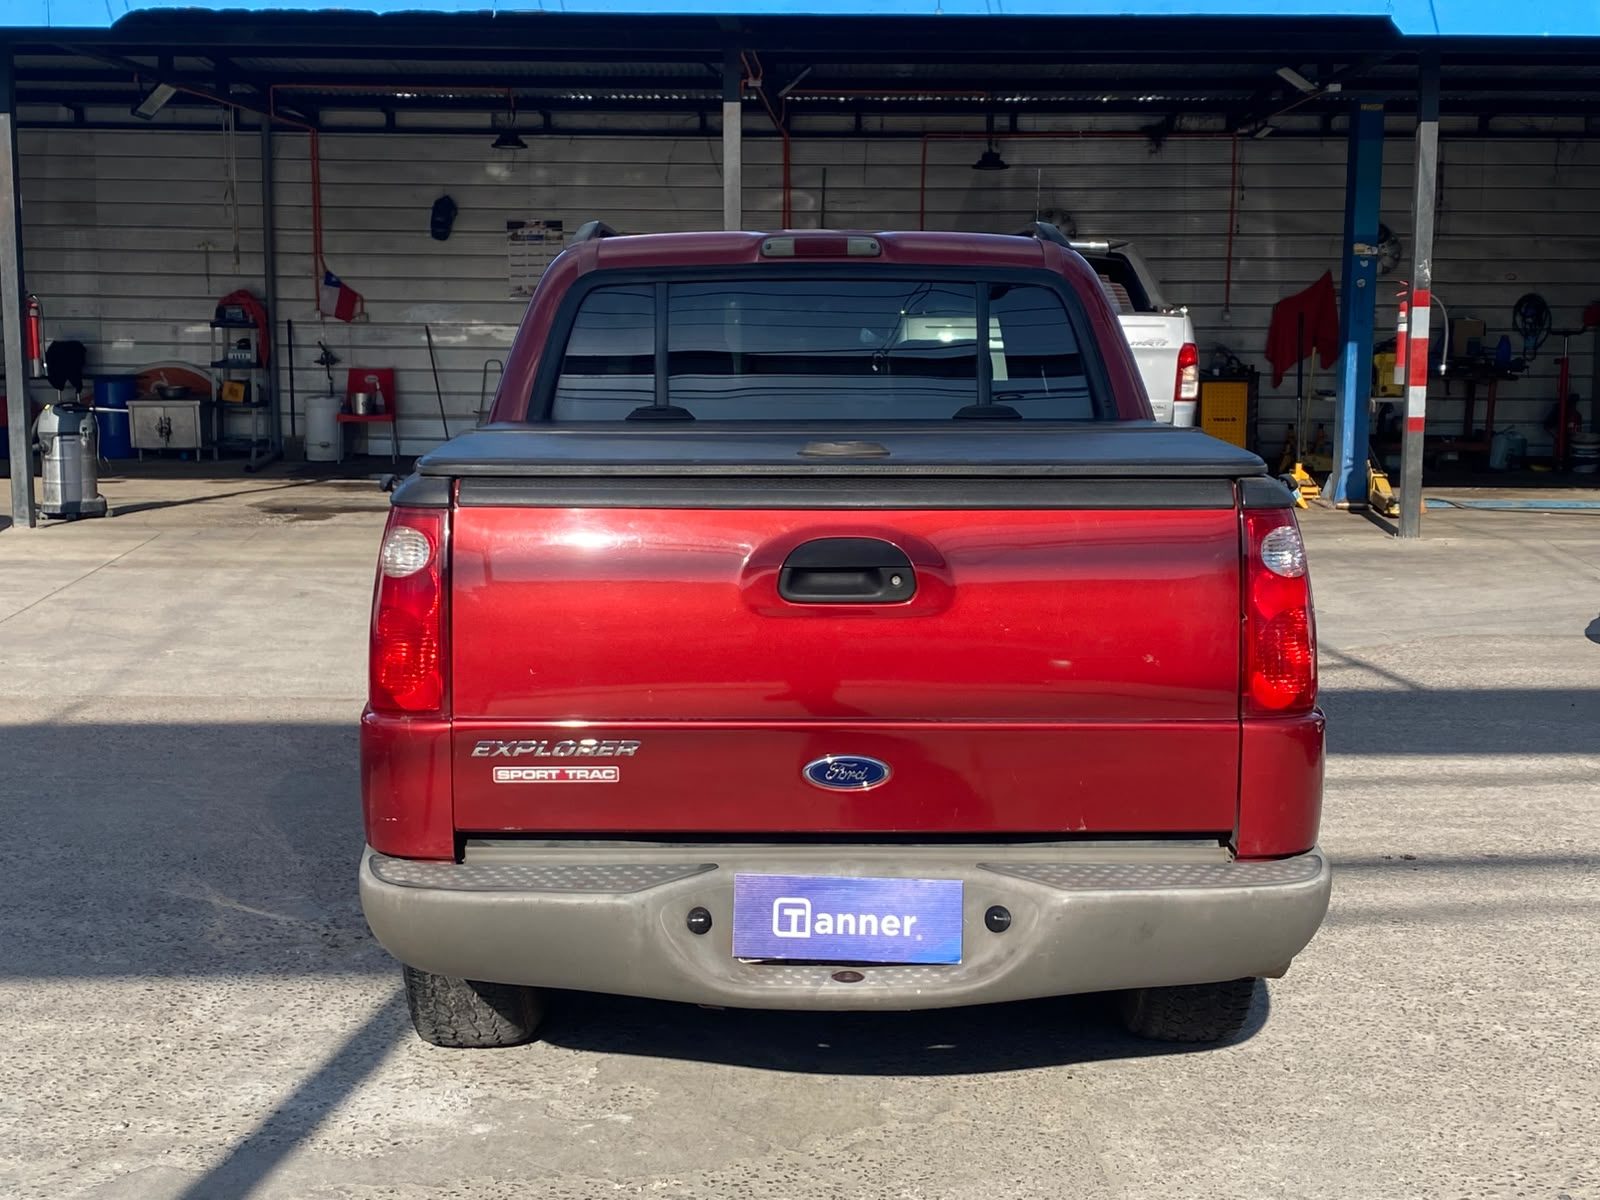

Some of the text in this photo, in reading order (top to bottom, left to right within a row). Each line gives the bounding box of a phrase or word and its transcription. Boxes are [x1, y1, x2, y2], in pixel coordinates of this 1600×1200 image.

[471, 738, 641, 758] EXPLORER
[496, 769, 617, 781] SPORT TRAC
[825, 761, 868, 780] Ford
[772, 897, 918, 938] Tanner
